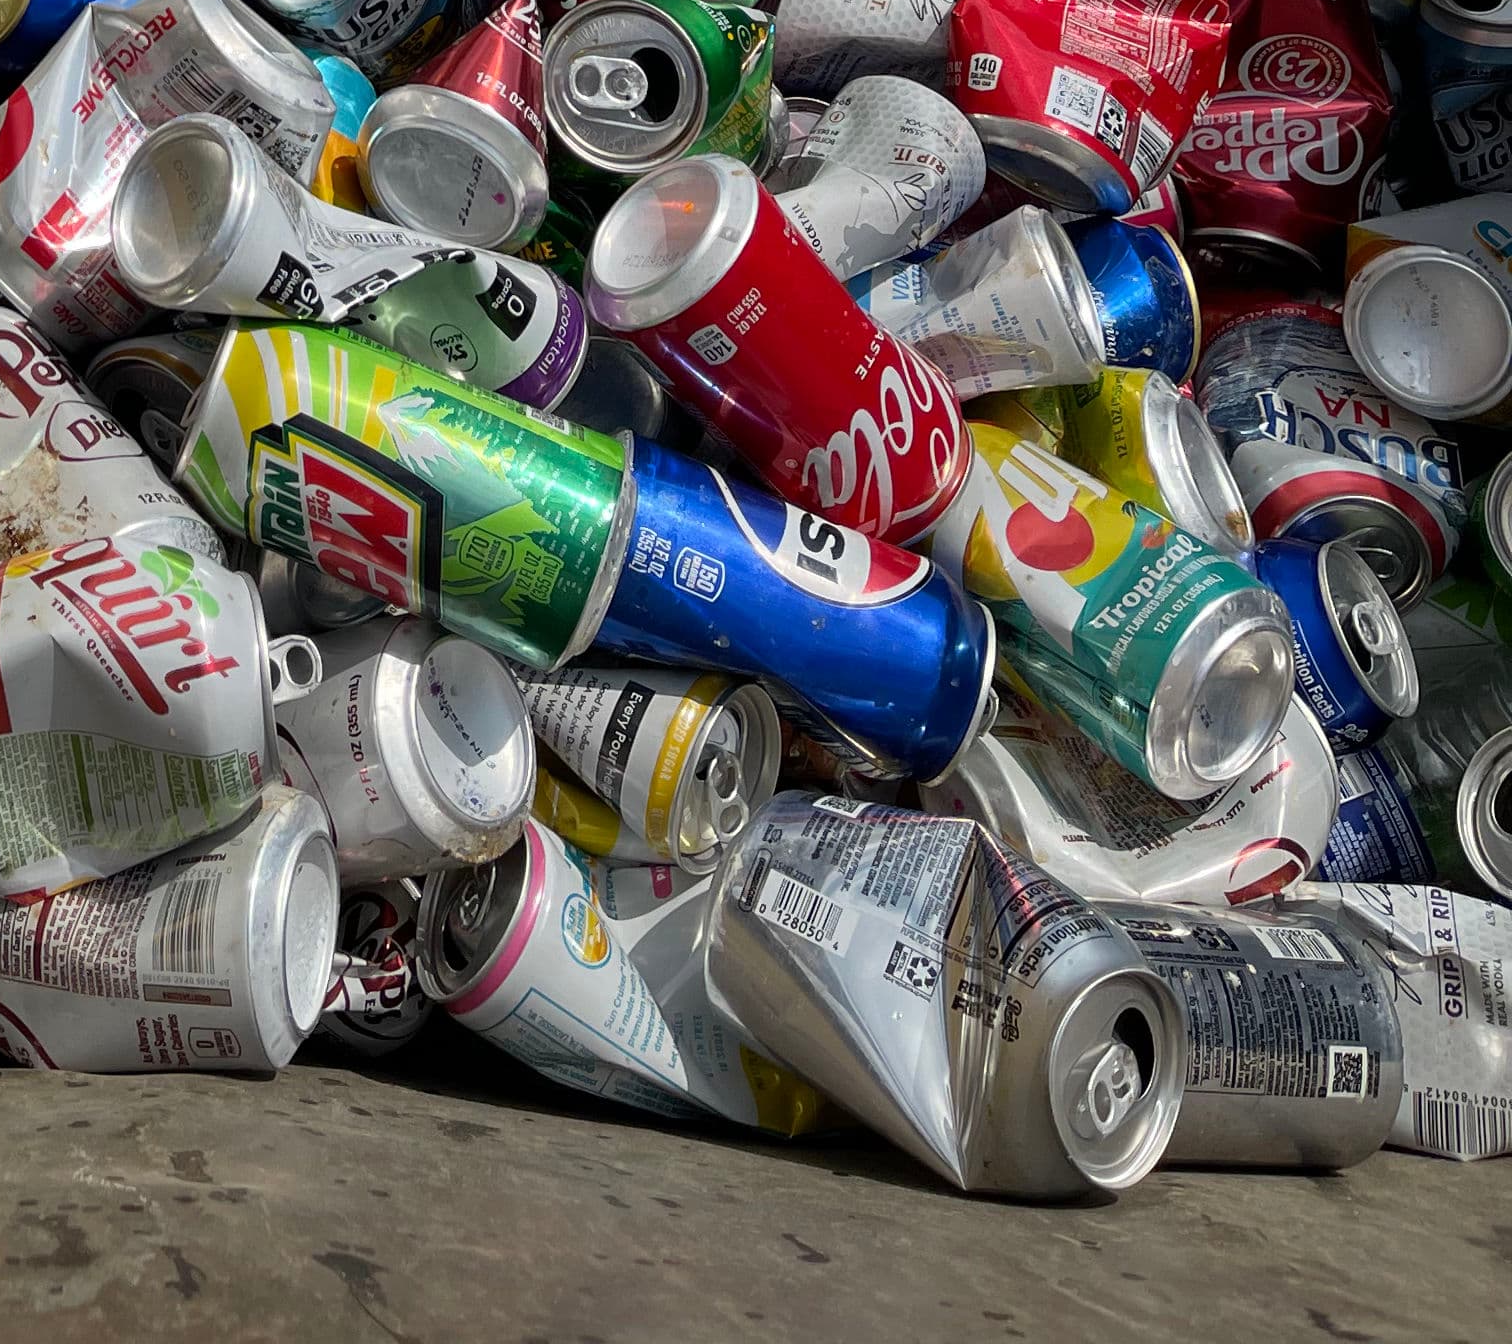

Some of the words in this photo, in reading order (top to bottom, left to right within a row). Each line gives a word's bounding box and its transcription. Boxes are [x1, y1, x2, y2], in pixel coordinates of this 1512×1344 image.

[90, 5, 178, 88] RECYCLE
[973, 57, 997, 74] 140
[1276, 51, 1322, 83] 23
[71, 84, 106, 124] ME
[537, 302, 571, 374] Cocktail
[1314, 386, 1392, 429] NA
[1256, 390, 1464, 490] BUSCH
[1088, 533, 1202, 632] Tropical
[86, 637, 134, 704] Quencher
[1431, 887, 1453, 923] RIP
[1443, 961, 1467, 1018] GRIP
